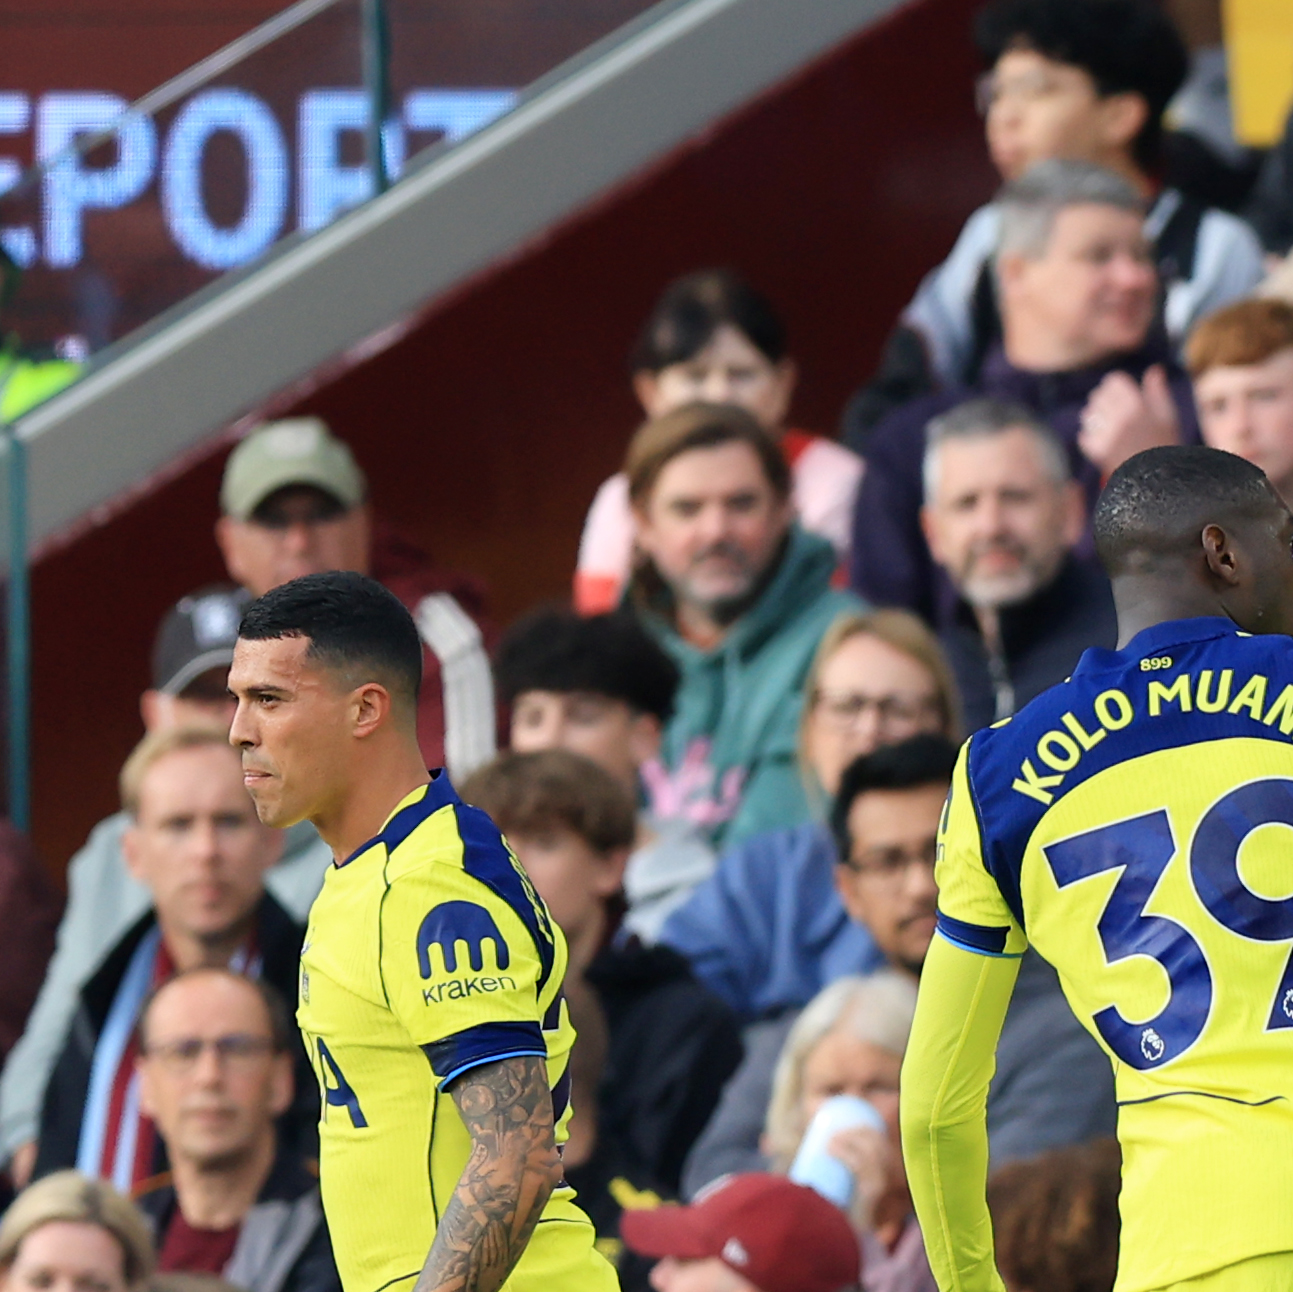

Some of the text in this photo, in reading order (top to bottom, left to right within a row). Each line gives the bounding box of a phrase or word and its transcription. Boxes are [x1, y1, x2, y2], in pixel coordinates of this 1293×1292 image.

[1139, 656, 1173, 672] 899
[1011, 689, 1135, 806] KOLO
[422, 974, 517, 1007] kraken
